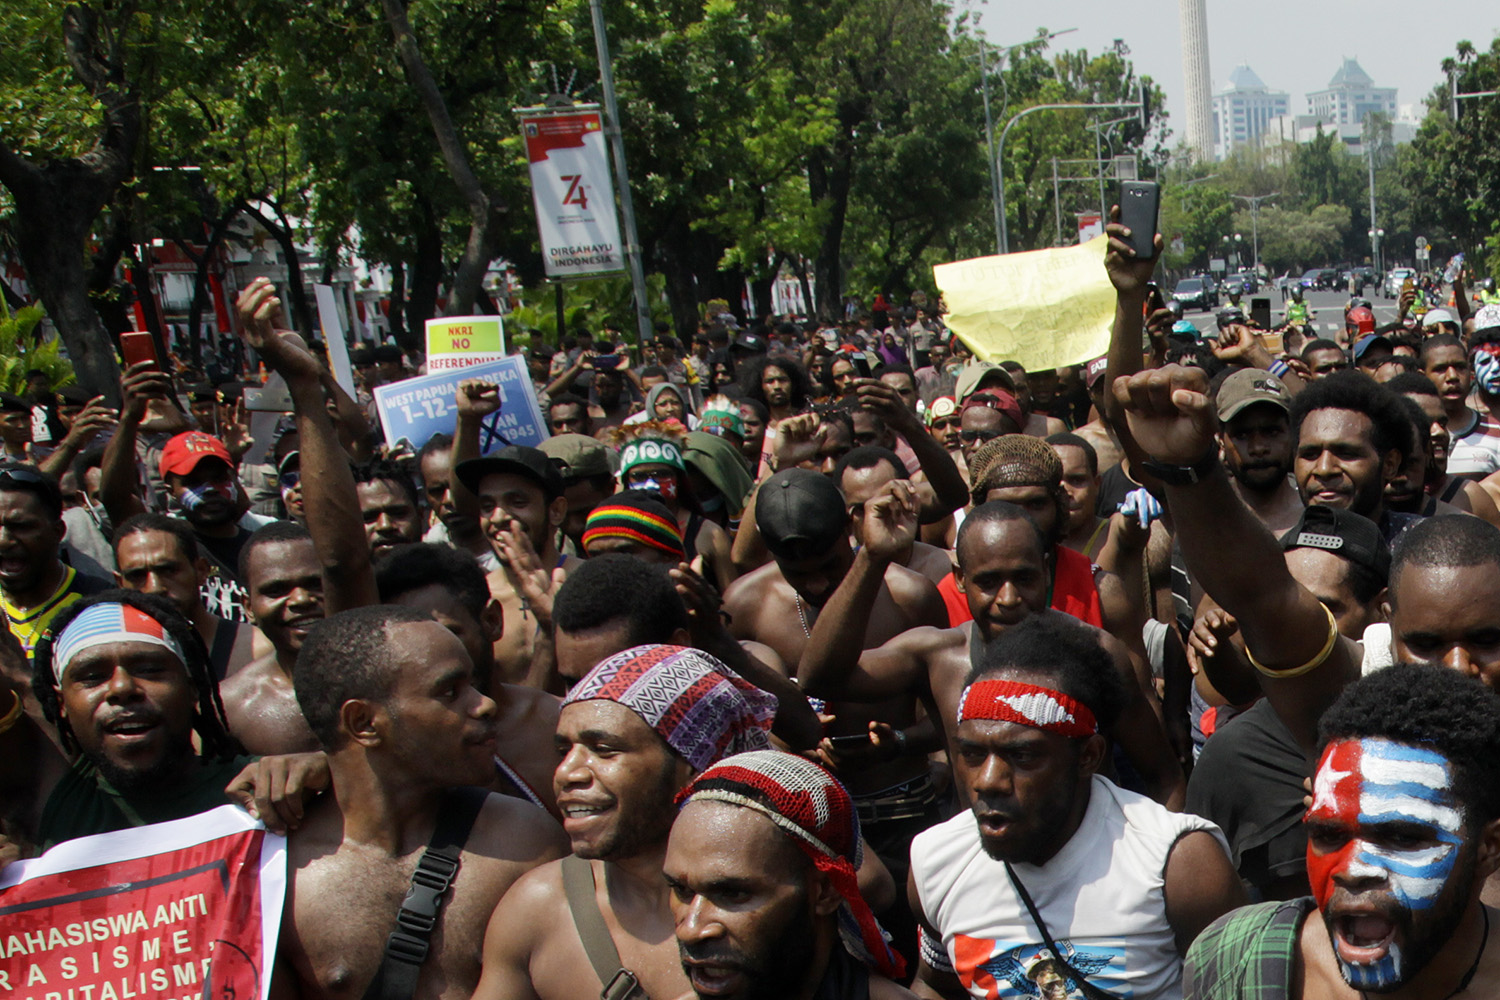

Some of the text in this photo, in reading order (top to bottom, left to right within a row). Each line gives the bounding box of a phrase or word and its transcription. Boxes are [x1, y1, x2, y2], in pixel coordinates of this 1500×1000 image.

[561, 174, 588, 209] 74
[551, 243, 613, 257] DIRGAHAYU
[555, 254, 613, 267] INDONESIA
[448, 326, 474, 336] NKRI
[452, 338, 470, 349] NO
[385, 391, 415, 409] WEST
[416, 383, 456, 399] PAPUA
[502, 424, 535, 441] 1945
[0, 893, 207, 959] AHASISWA ANTI
